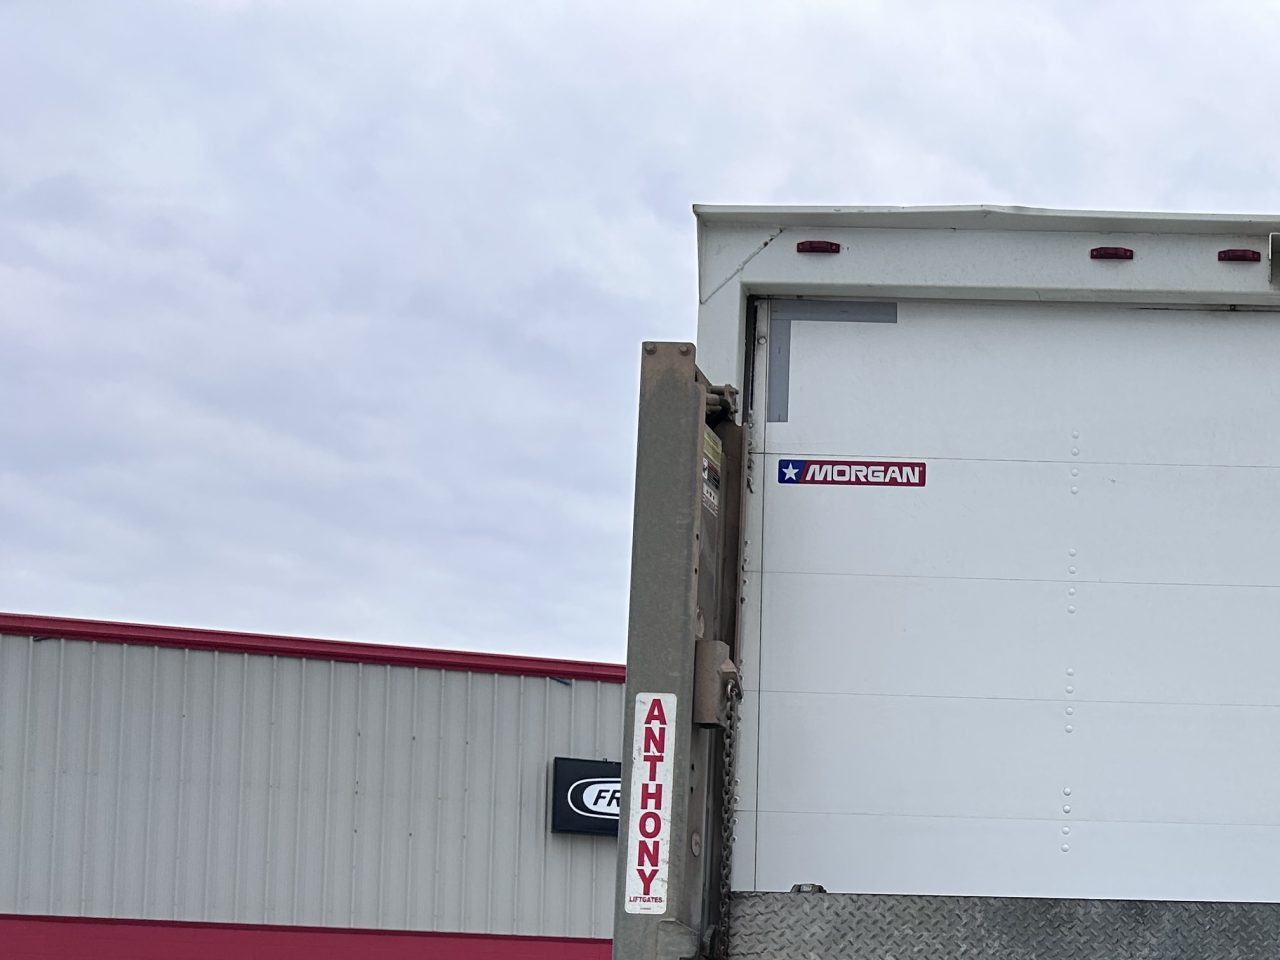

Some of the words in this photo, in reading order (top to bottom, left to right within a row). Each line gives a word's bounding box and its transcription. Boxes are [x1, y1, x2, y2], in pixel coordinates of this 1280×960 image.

[805, 464, 920, 484] MORGAN
[636, 699, 667, 895] ANTHONY
[628, 895, 663, 904] LIFTGATES
